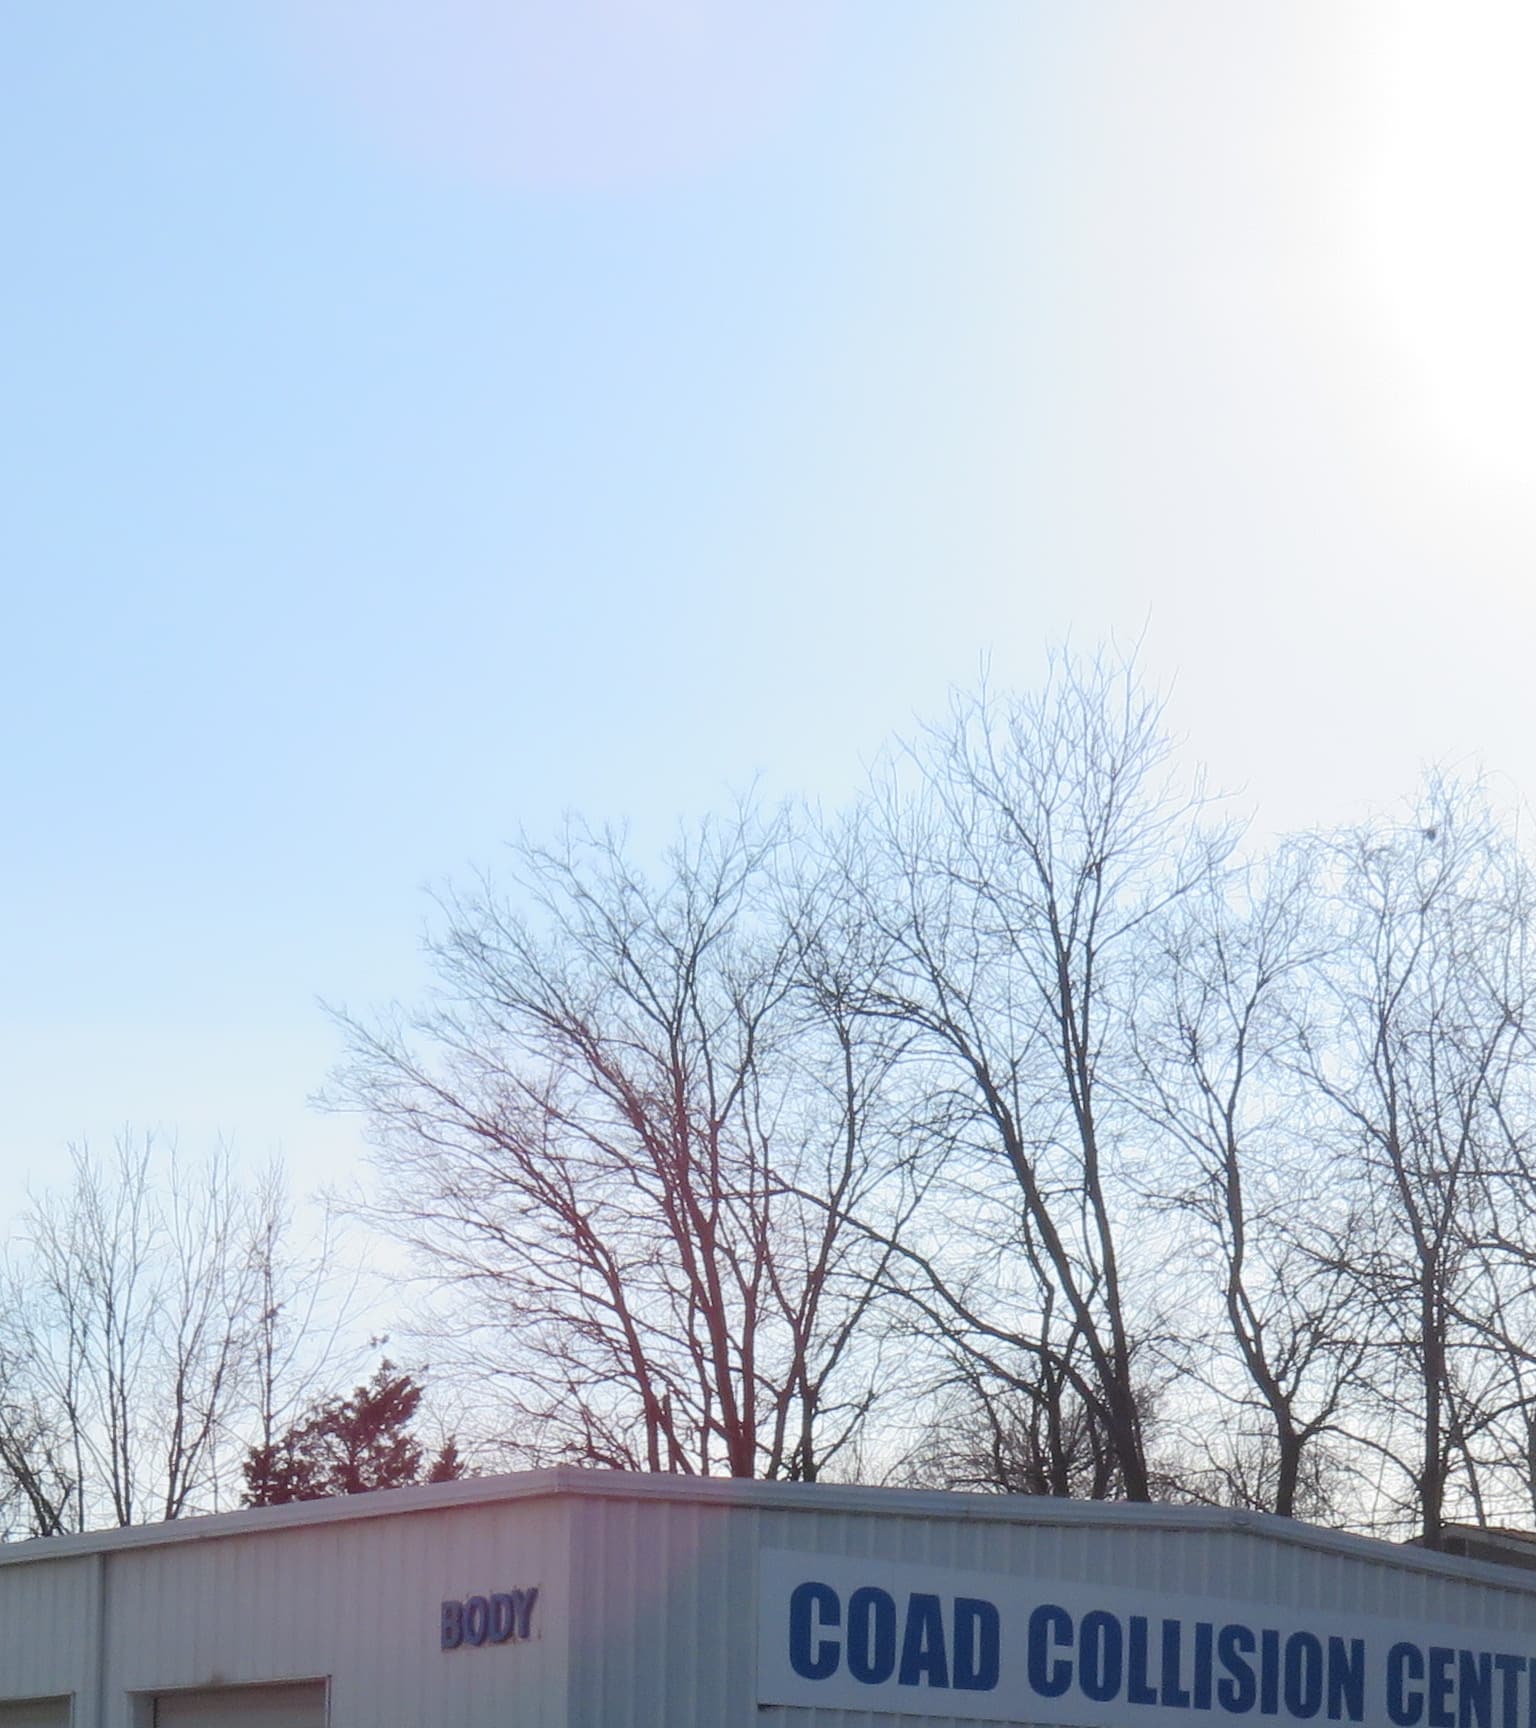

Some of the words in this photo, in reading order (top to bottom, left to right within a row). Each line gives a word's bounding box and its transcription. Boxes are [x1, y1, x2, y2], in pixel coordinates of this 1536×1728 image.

[441, 1587, 538, 1650] BODY
[789, 1582, 1000, 1692] COAD
[1028, 1605, 1366, 1723] COLLISION
